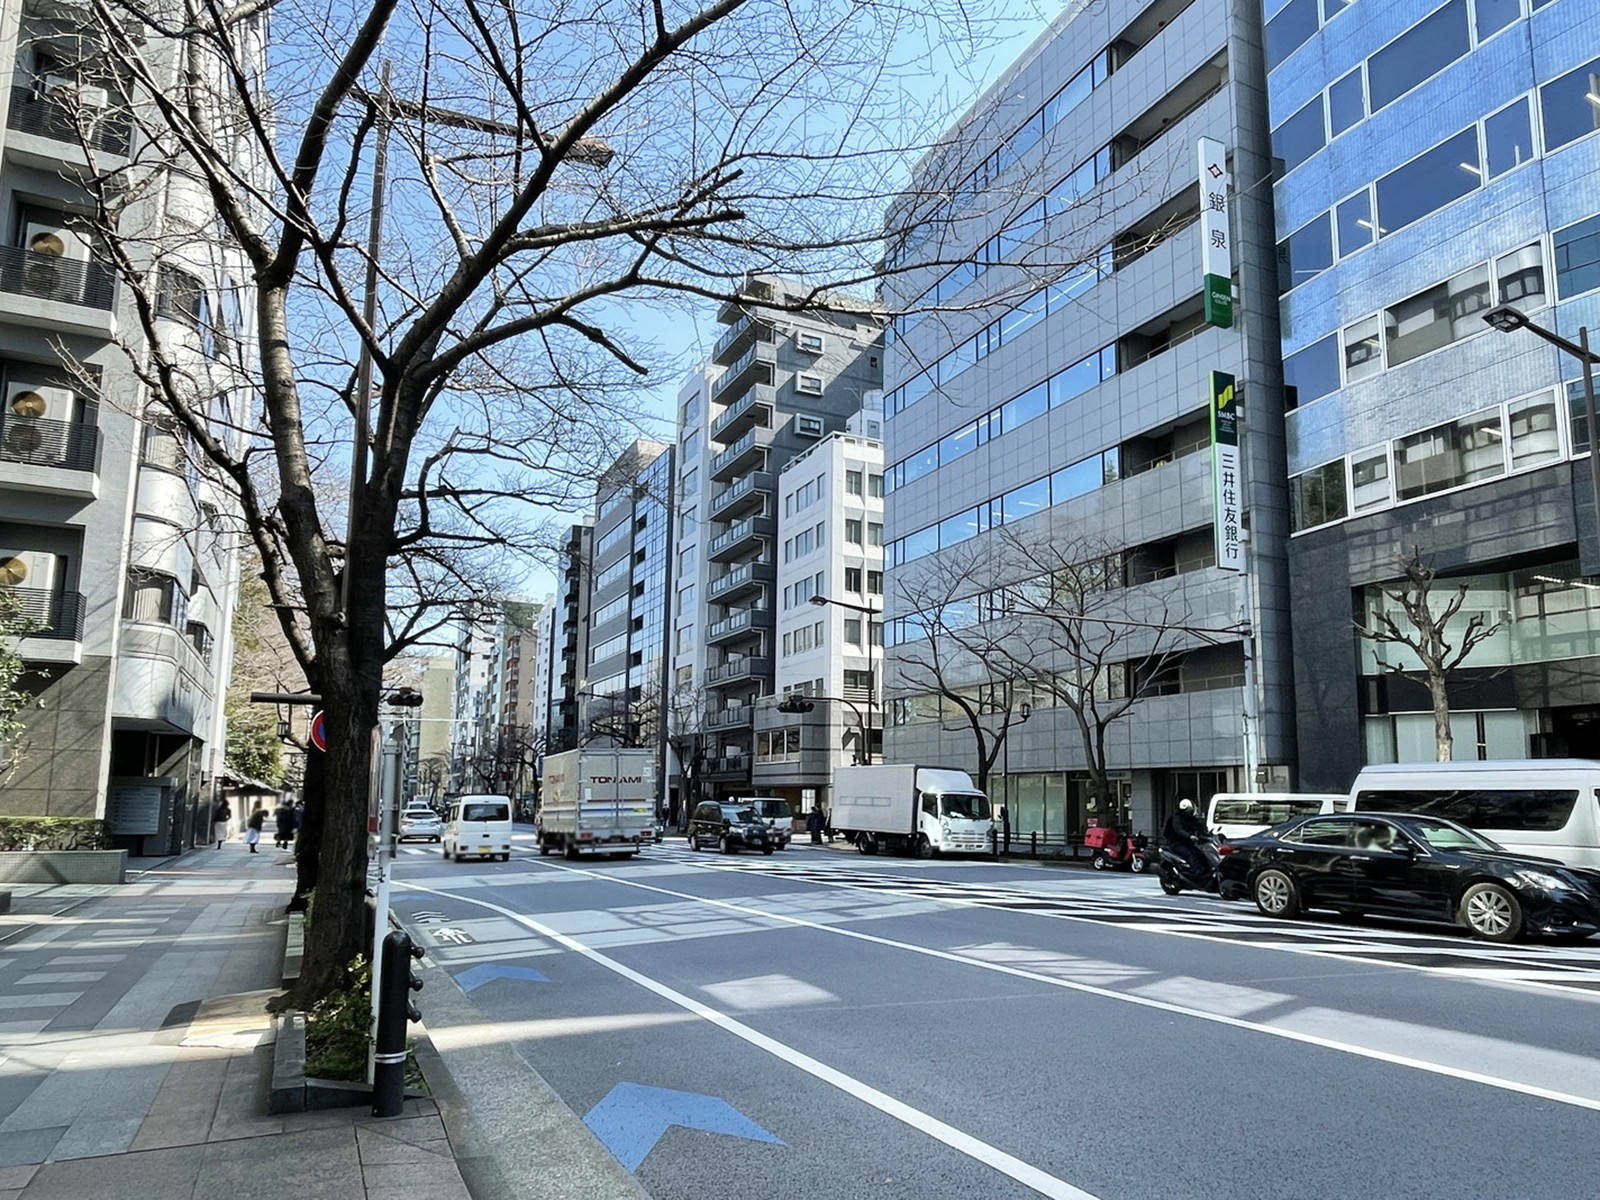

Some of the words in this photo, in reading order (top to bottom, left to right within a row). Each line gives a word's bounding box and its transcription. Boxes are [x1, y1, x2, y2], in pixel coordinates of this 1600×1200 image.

[1208, 191, 1227, 249] 銀泉
[1217, 410, 1236, 421] SMBC
[1221, 453, 1239, 560] 三井住友銀行
[590, 776, 642, 784] TONAMI
